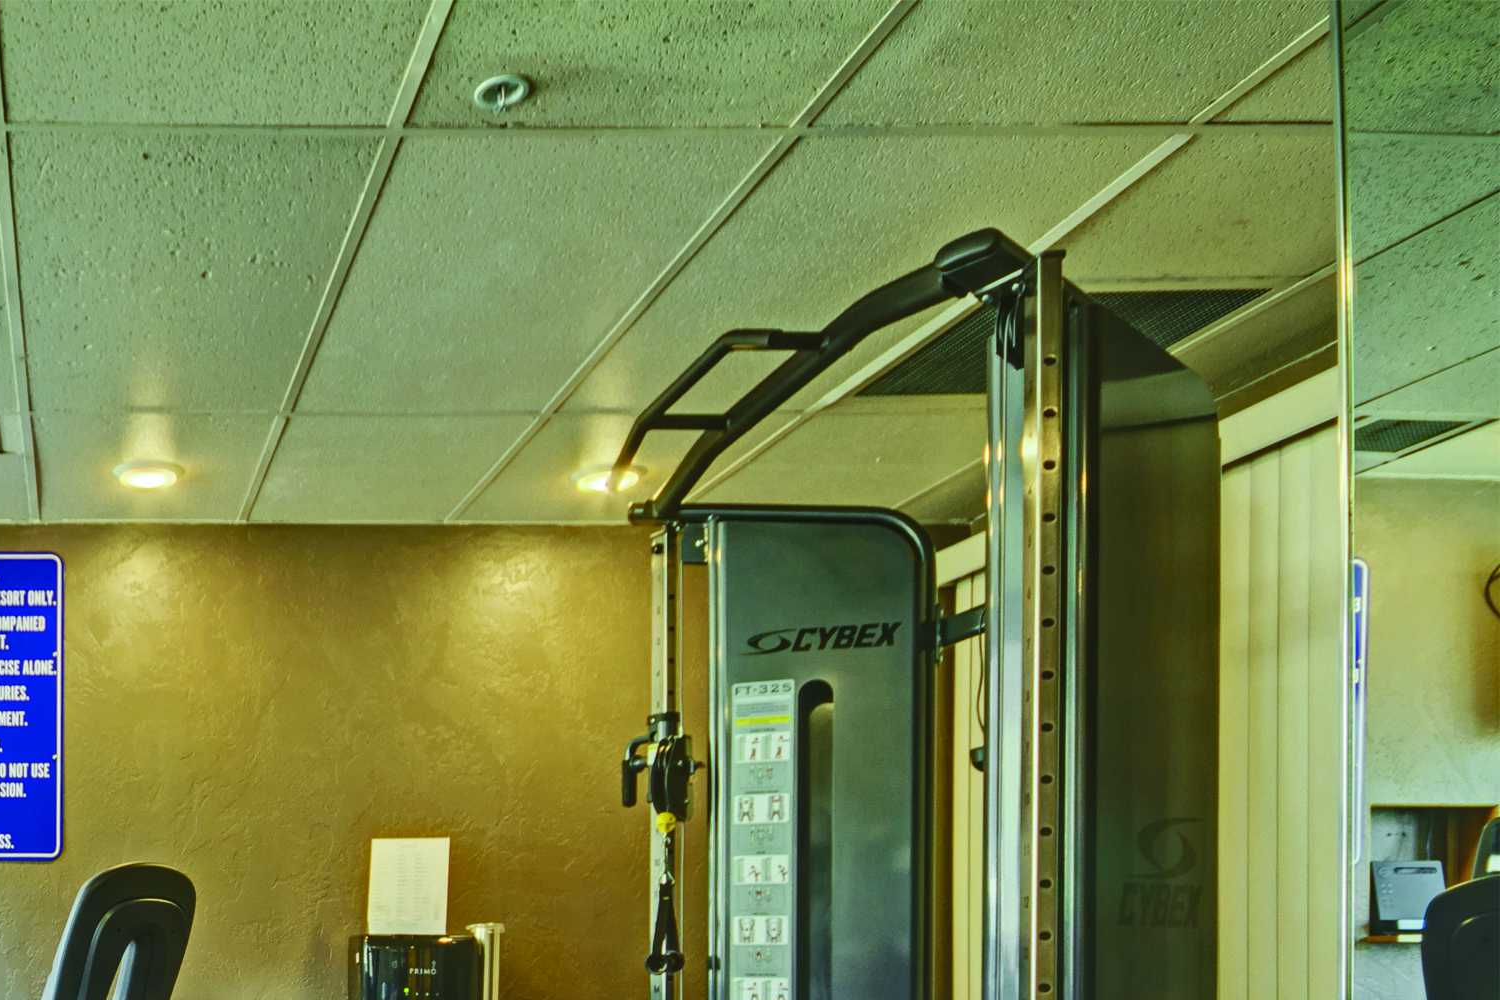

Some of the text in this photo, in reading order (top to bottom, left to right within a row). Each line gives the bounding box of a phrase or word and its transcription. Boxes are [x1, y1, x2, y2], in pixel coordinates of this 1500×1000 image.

[28, 590, 56, 606] ONLY.
[791, 622, 902, 652] CYBEX
[22, 660, 56, 675] ALONE.
[735, 683, 791, 696] FT-325
[9, 763, 29, 778] NOT
[31, 763, 50, 778] USE
[1117, 882, 1203, 928] CYBEX
